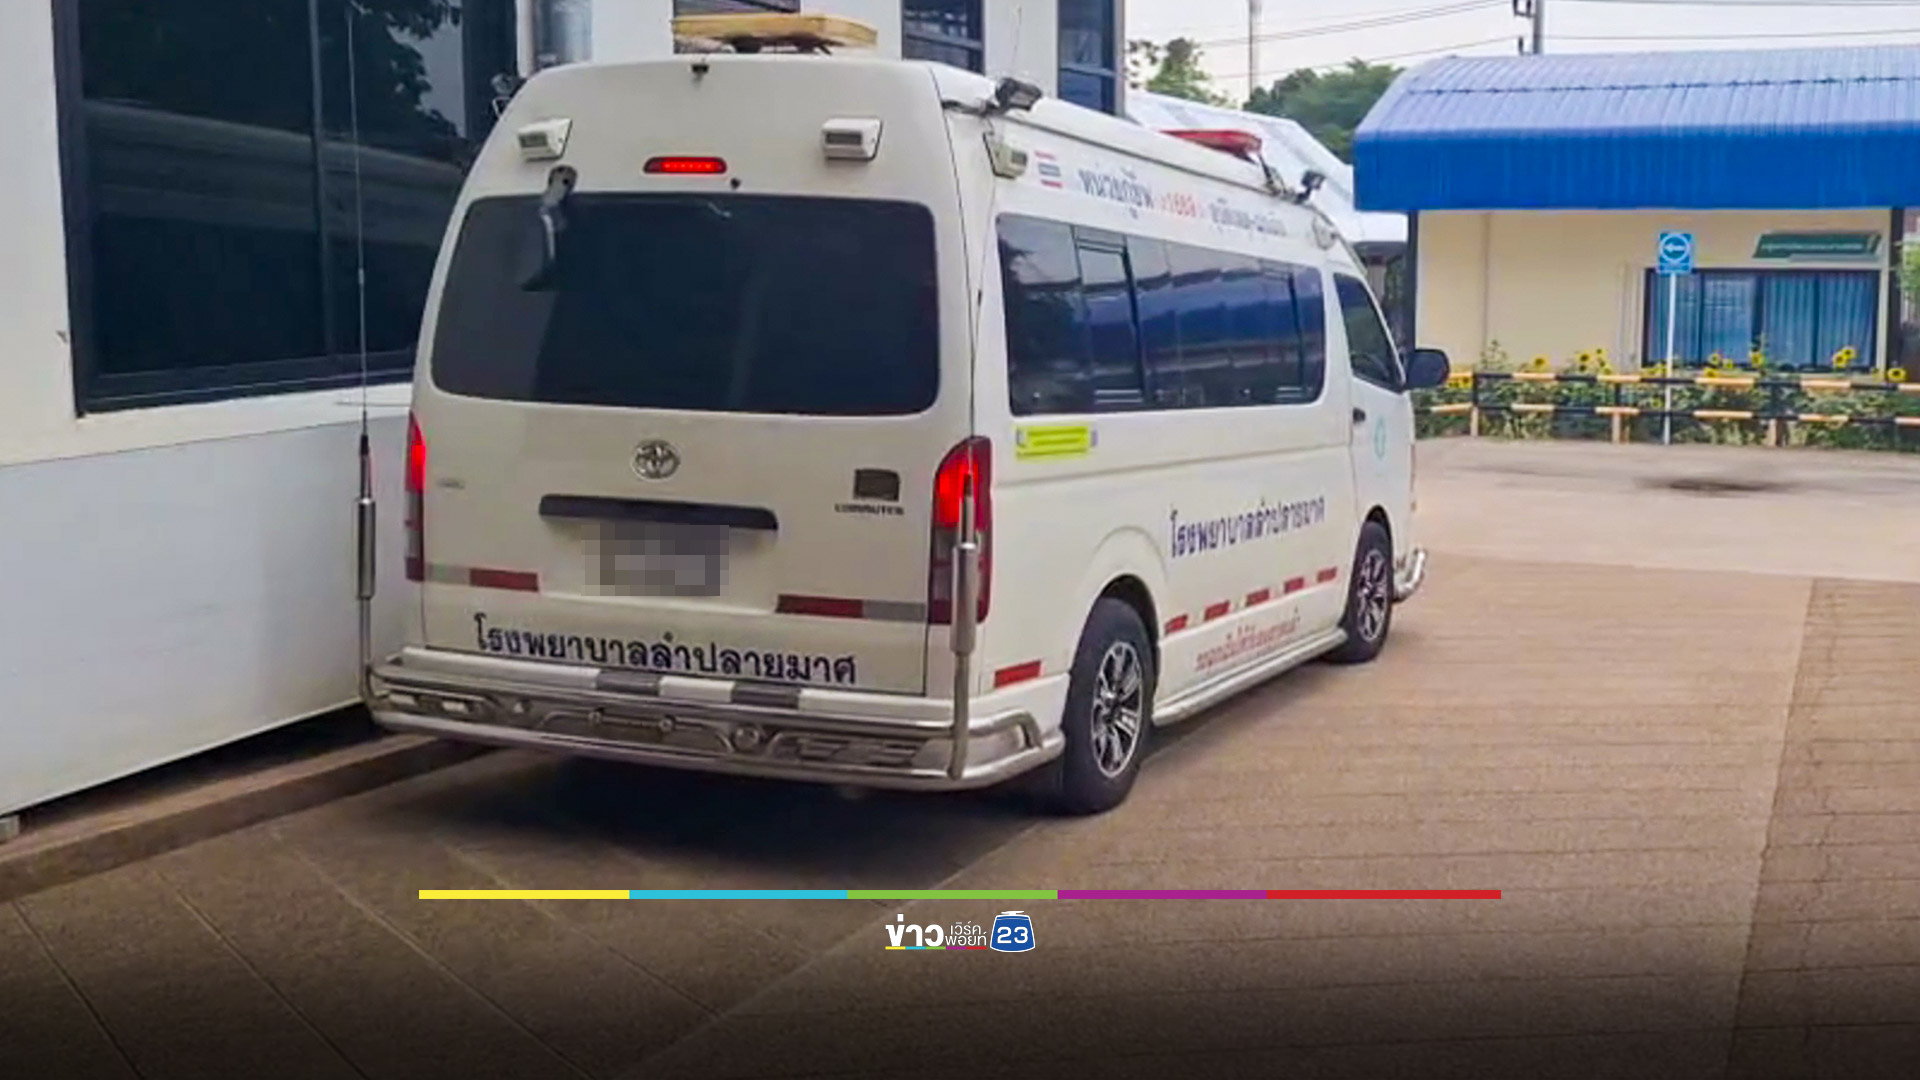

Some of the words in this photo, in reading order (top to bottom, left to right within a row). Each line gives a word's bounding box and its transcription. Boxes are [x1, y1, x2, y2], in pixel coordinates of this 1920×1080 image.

[1170, 497, 1325, 558] โรงพยาบาลลำปลายมาศ
[474, 613, 858, 685] โรงพยาบาลลำปลายมาศ
